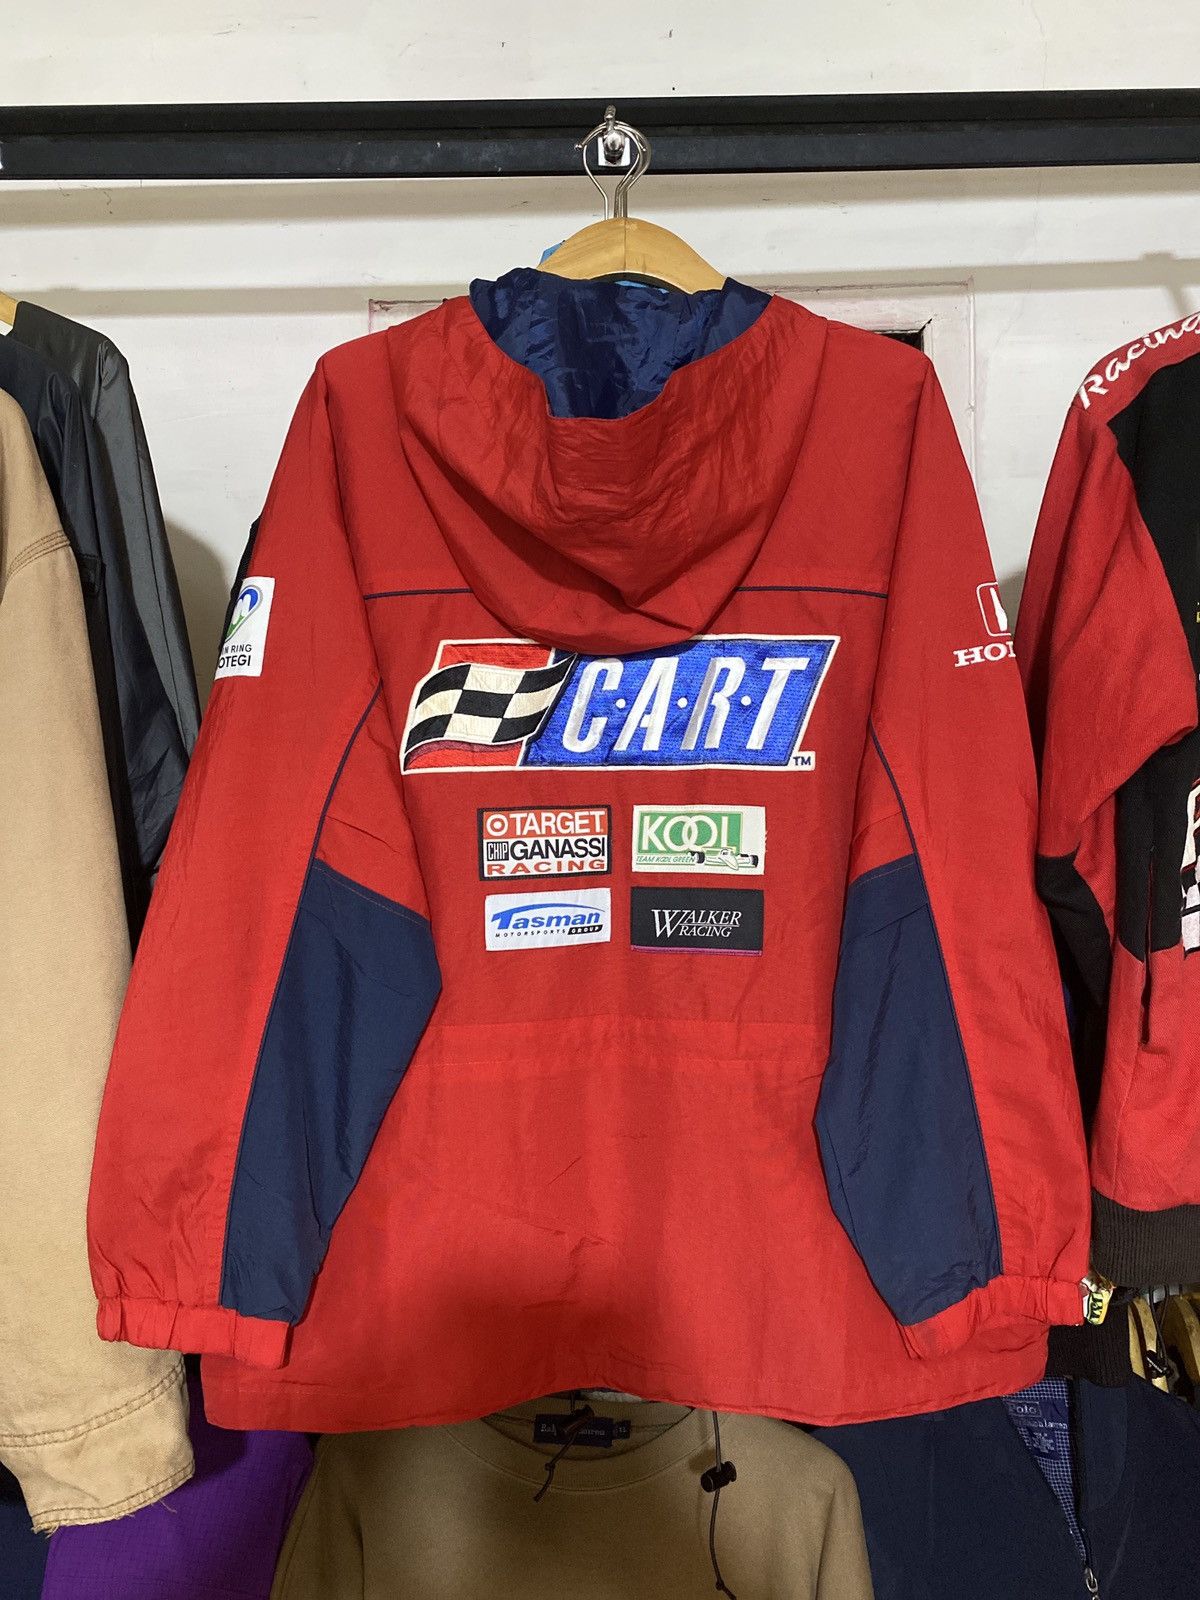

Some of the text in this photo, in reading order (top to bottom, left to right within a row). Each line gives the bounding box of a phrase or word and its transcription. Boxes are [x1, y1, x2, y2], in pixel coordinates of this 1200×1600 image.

[230, 644, 252, 654] RING
[218, 654, 252, 669] OTEGI
[509, 810, 606, 836] TARGET
[641, 815, 736, 852] KOOL
[487, 837, 605, 861] CHIP GANASSI
[486, 859, 605, 875] RACING
[491, 904, 604, 930] Tasman
[651, 909, 742, 938] WALKER
[494, 925, 600, 938] MOTORSPORTS GROUP
[678, 926, 732, 938] RACING
